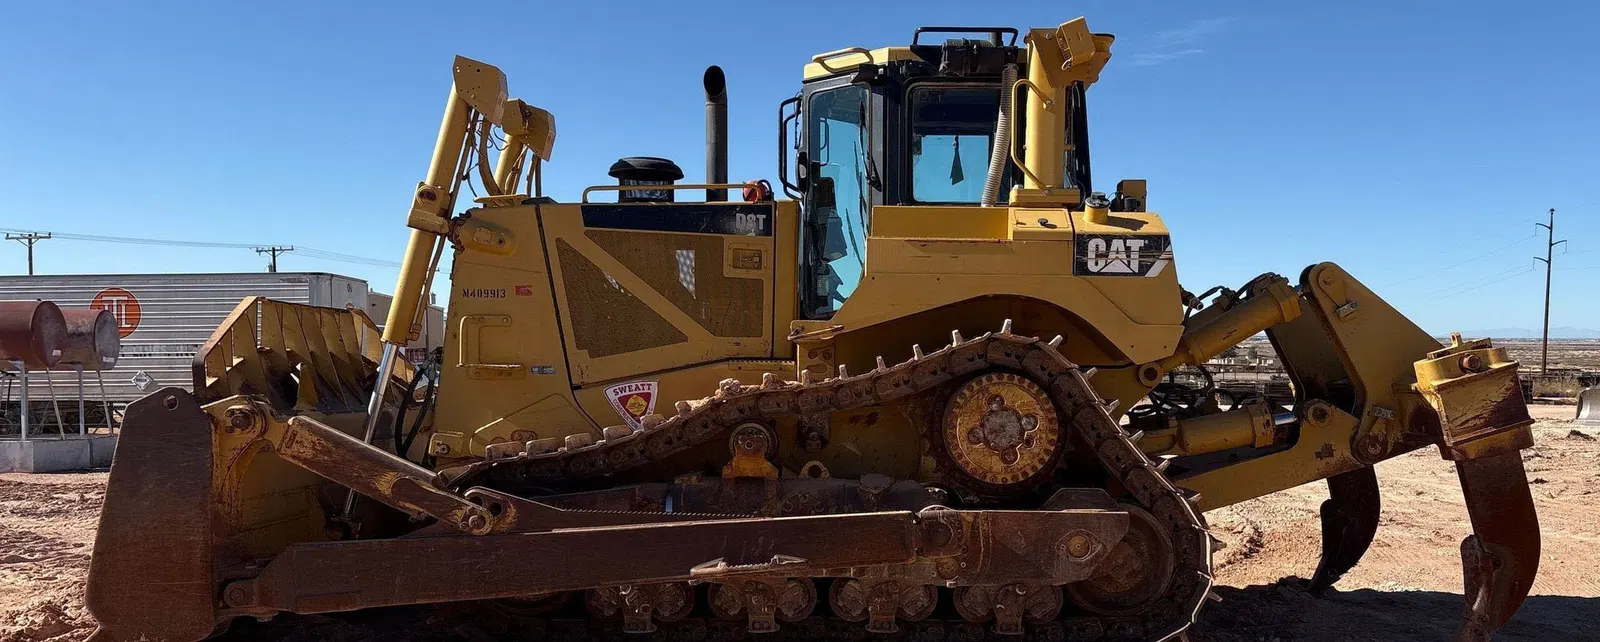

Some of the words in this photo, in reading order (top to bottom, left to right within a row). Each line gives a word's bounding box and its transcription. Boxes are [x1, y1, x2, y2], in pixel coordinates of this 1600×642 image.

[735, 212, 766, 230] D8T
[1087, 238, 1145, 273] CAT
[462, 287, 506, 299] M409913
[612, 383, 652, 396] SWEATT
